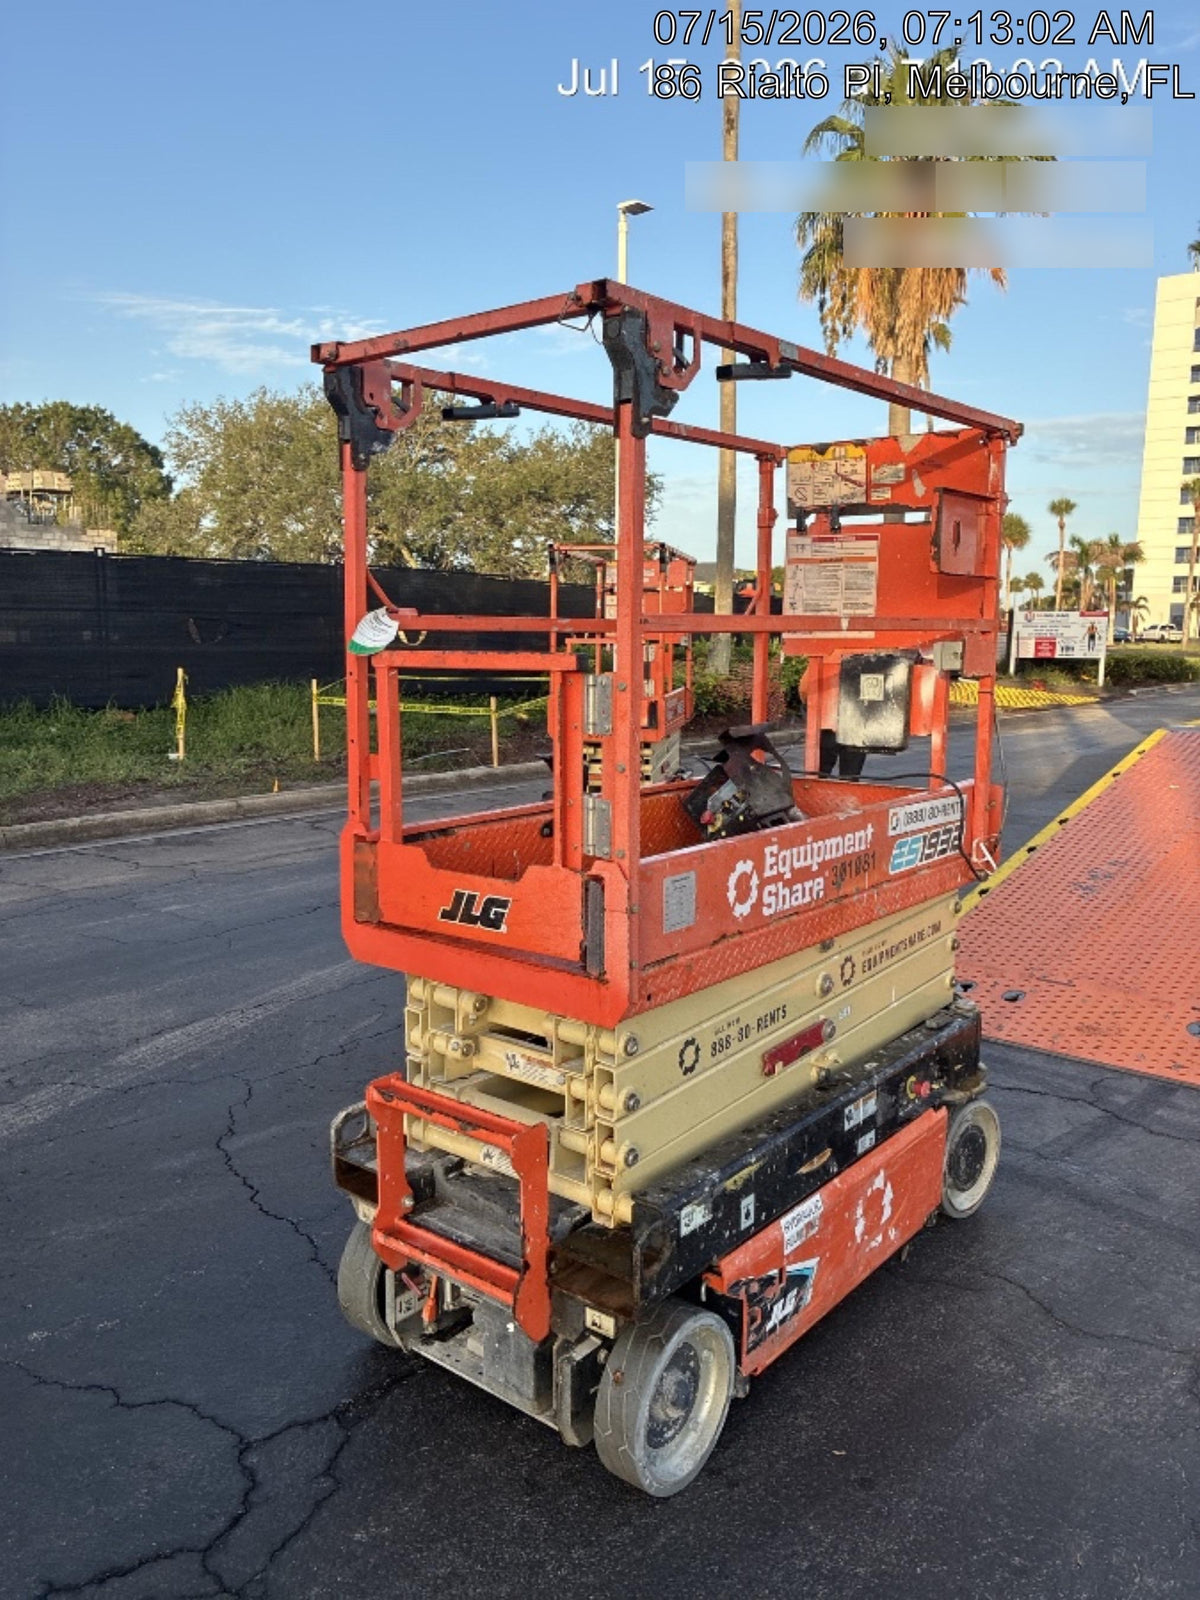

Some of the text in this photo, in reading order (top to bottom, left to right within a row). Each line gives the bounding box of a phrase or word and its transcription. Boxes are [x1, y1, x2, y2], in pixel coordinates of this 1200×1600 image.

[764, 822, 875, 880] Equipment
[438, 889, 512, 932] JLG
[762, 877, 825, 916] Share
